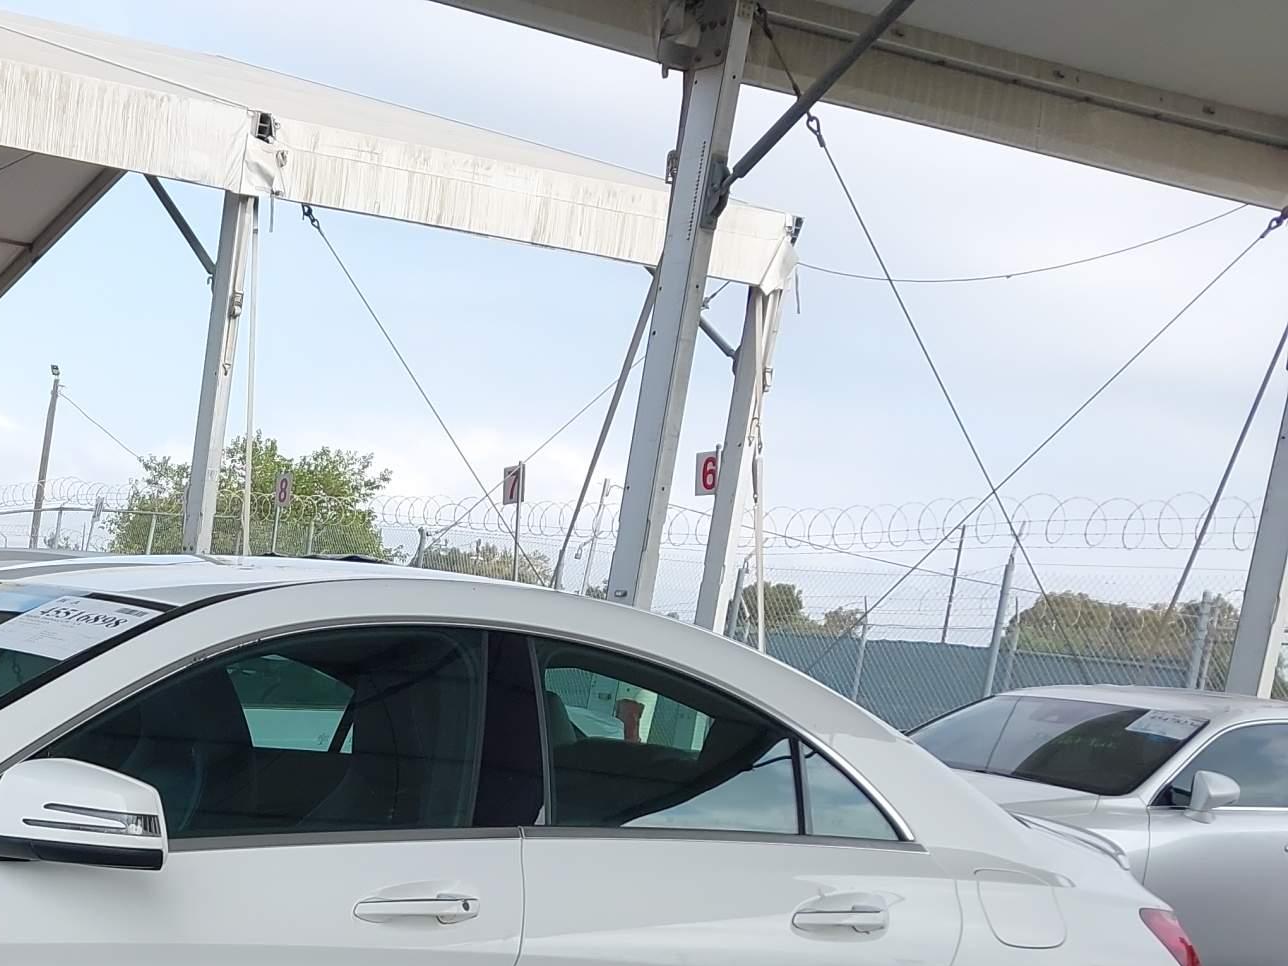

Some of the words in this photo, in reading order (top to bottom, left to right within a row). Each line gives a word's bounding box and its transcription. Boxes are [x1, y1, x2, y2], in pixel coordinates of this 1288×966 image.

[508, 470, 519, 499] 7
[703, 457, 716, 490] 6
[279, 478, 287, 502] 8
[40, 606, 128, 628] 45516898
